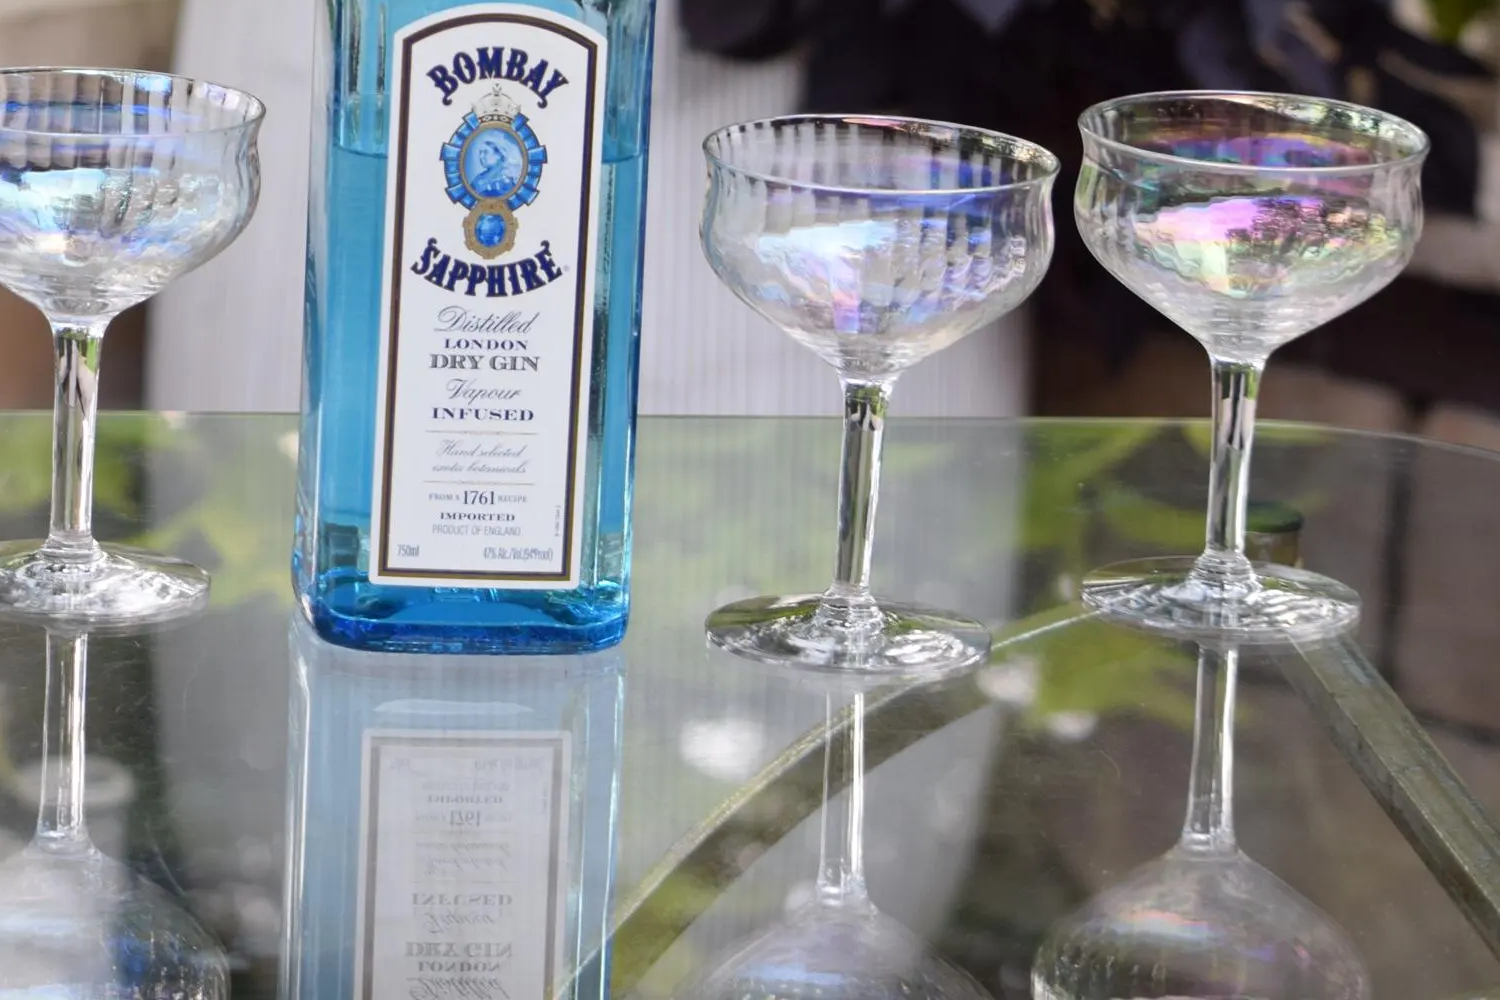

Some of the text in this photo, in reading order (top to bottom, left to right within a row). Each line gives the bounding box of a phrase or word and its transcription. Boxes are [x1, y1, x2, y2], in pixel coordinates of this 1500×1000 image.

[426, 46, 569, 109] BOMBAY
[410, 237, 563, 298] SAPPHIRE
[433, 305, 541, 334] Distilled
[444, 338, 528, 351] LONDON
[429, 353, 540, 372] DRY GIN
[445, 378, 521, 406] Vapour
[431, 407, 535, 421] INFUSED
[436, 439, 482, 457] Hand
[428, 492, 454, 502] FROM
[462, 489, 497, 505] 1761
[439, 511, 516, 522] IMPORTED
[431, 523, 522, 537] PRODUCT OF ENGLAND
